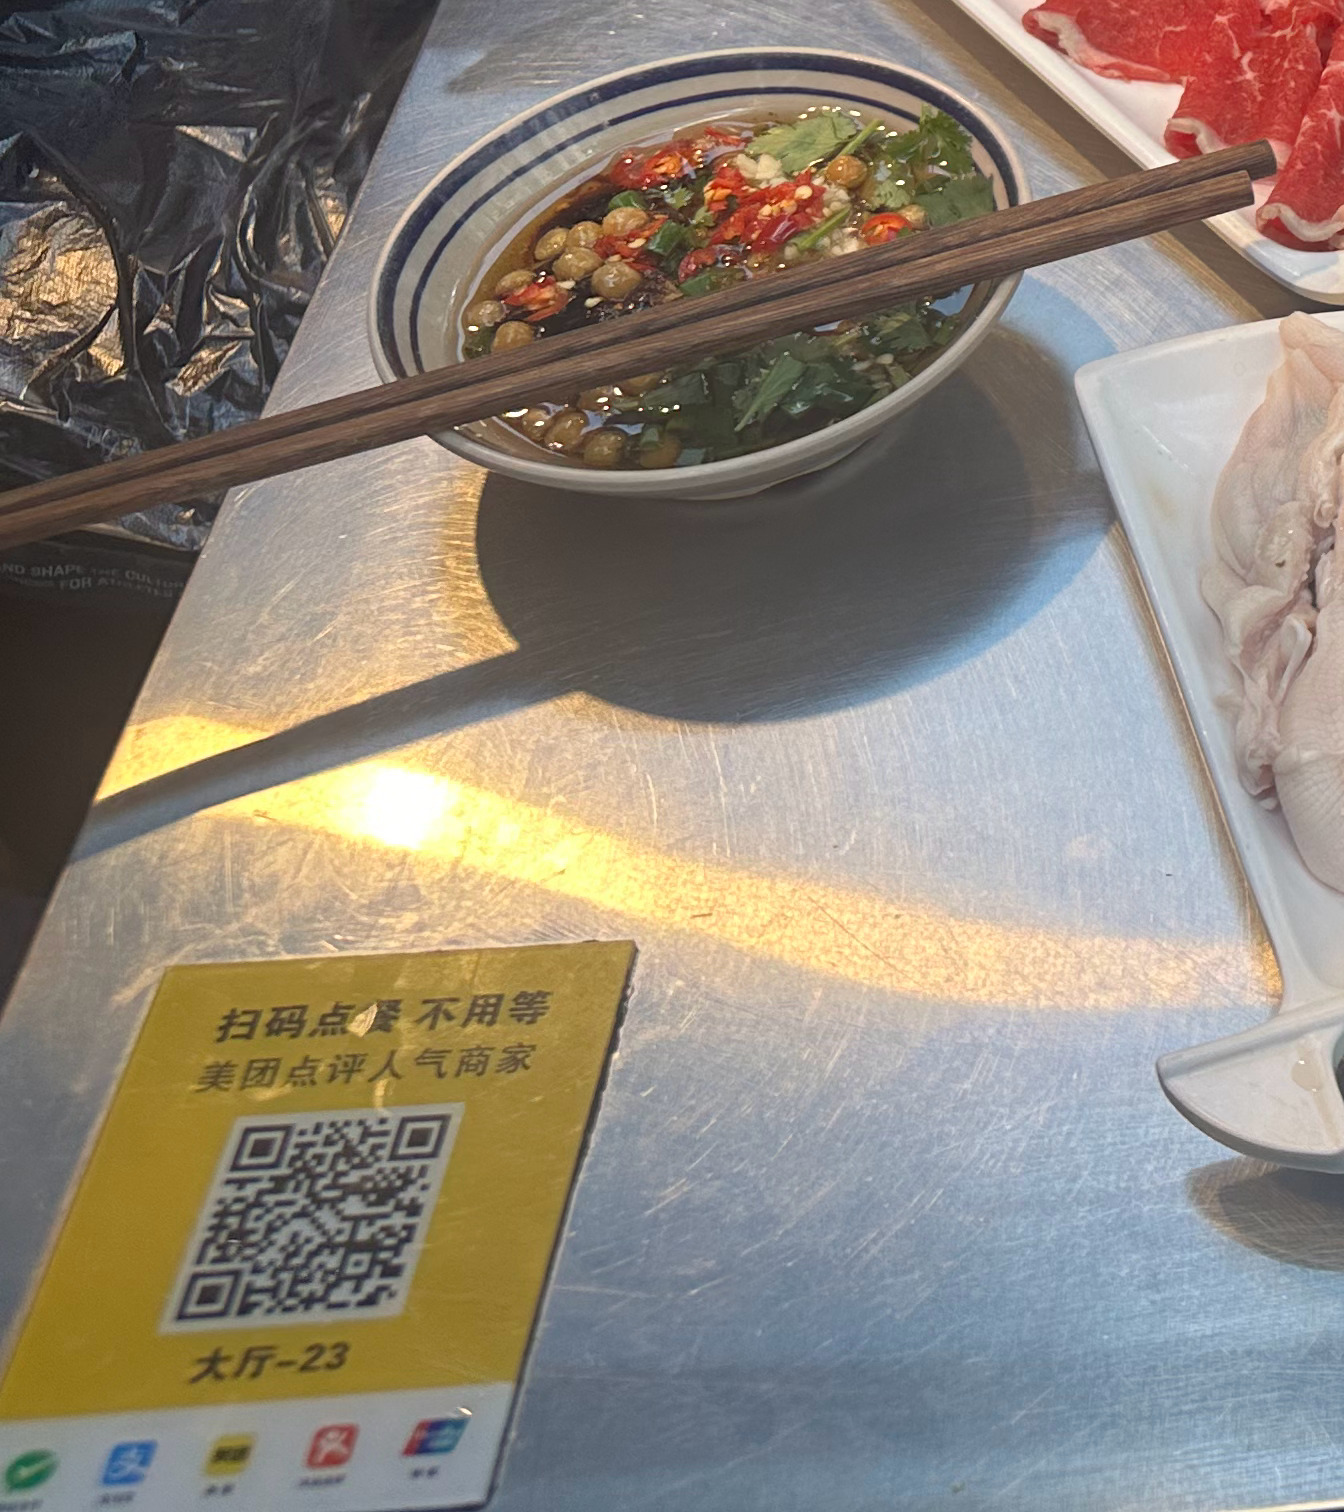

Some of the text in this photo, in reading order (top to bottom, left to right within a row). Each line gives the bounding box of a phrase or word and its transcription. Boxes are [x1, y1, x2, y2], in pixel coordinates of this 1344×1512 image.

[216, 990, 552, 1042] 扫码点餐 不用等
[196, 1044, 536, 1093] 美团点评人气商家
[188, 1342, 349, 1384] 大厅-23
